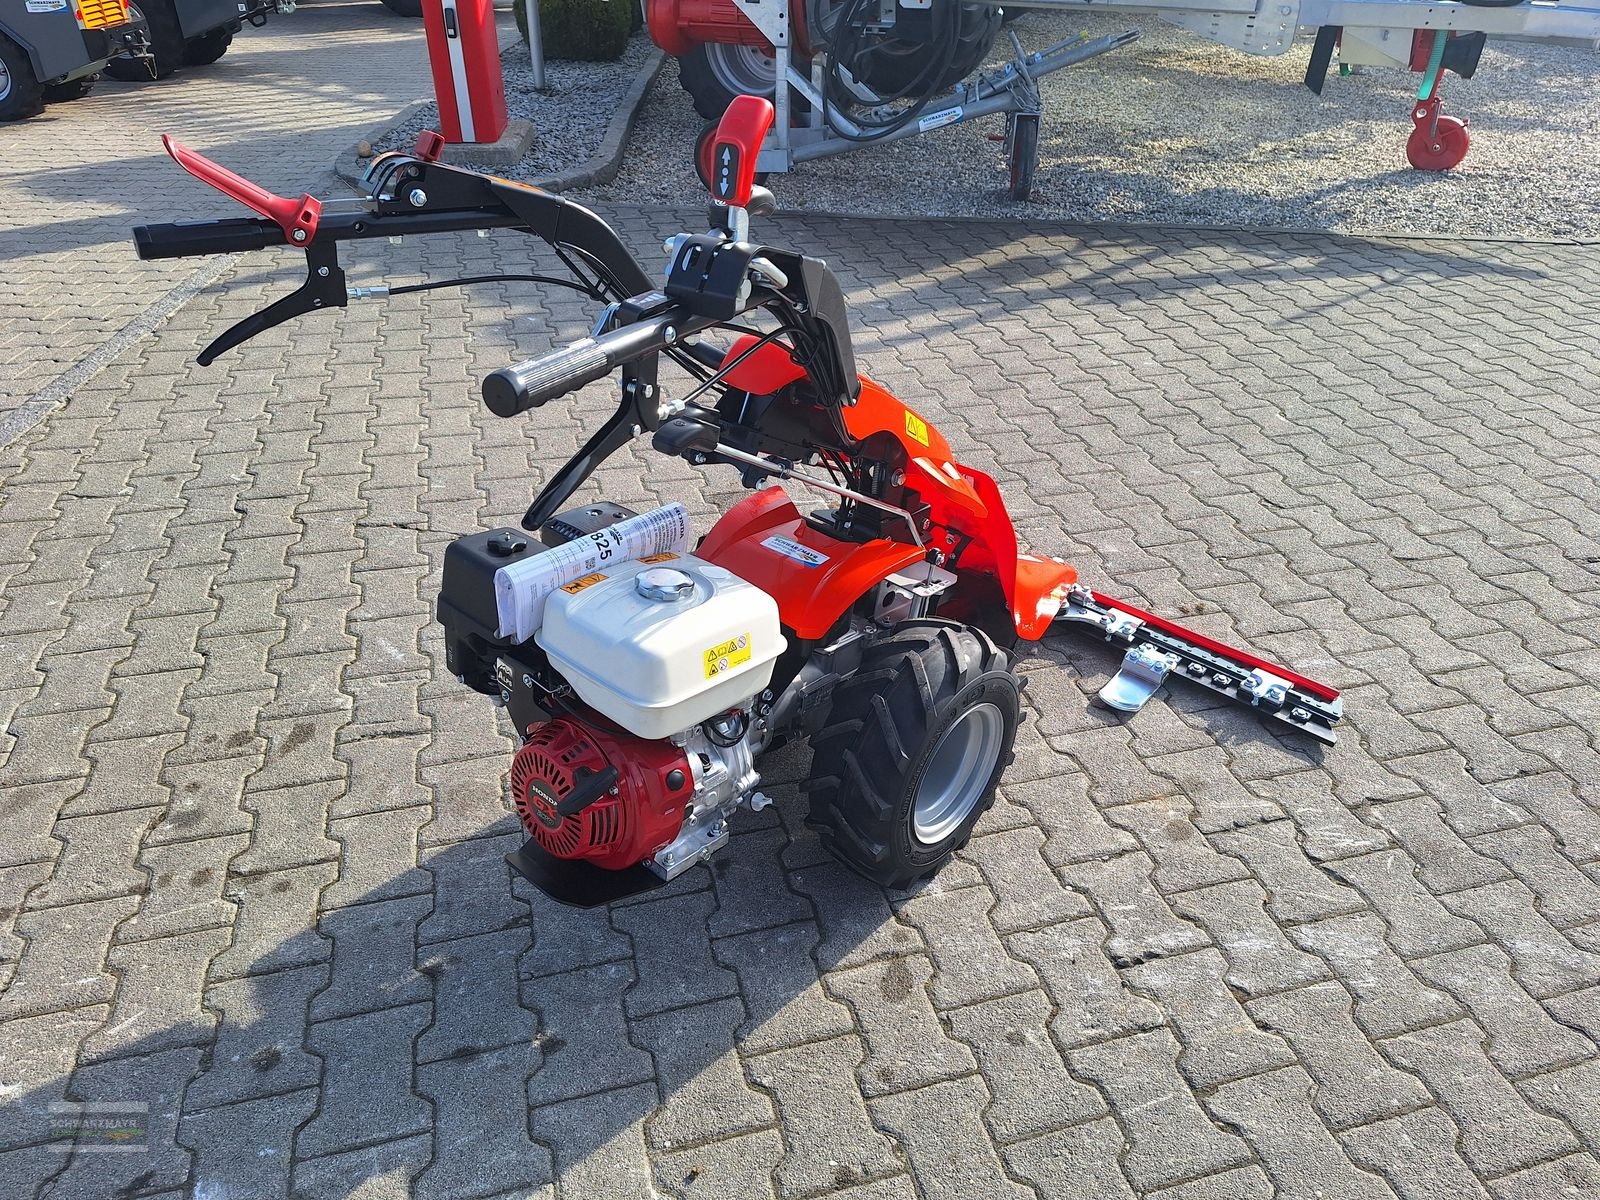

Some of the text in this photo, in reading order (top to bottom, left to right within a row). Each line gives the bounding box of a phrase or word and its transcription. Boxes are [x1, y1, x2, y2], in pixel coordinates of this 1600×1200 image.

[673, 506, 685, 540] HONDA
[590, 532, 612, 560] 825
[532, 795, 558, 821] GX
